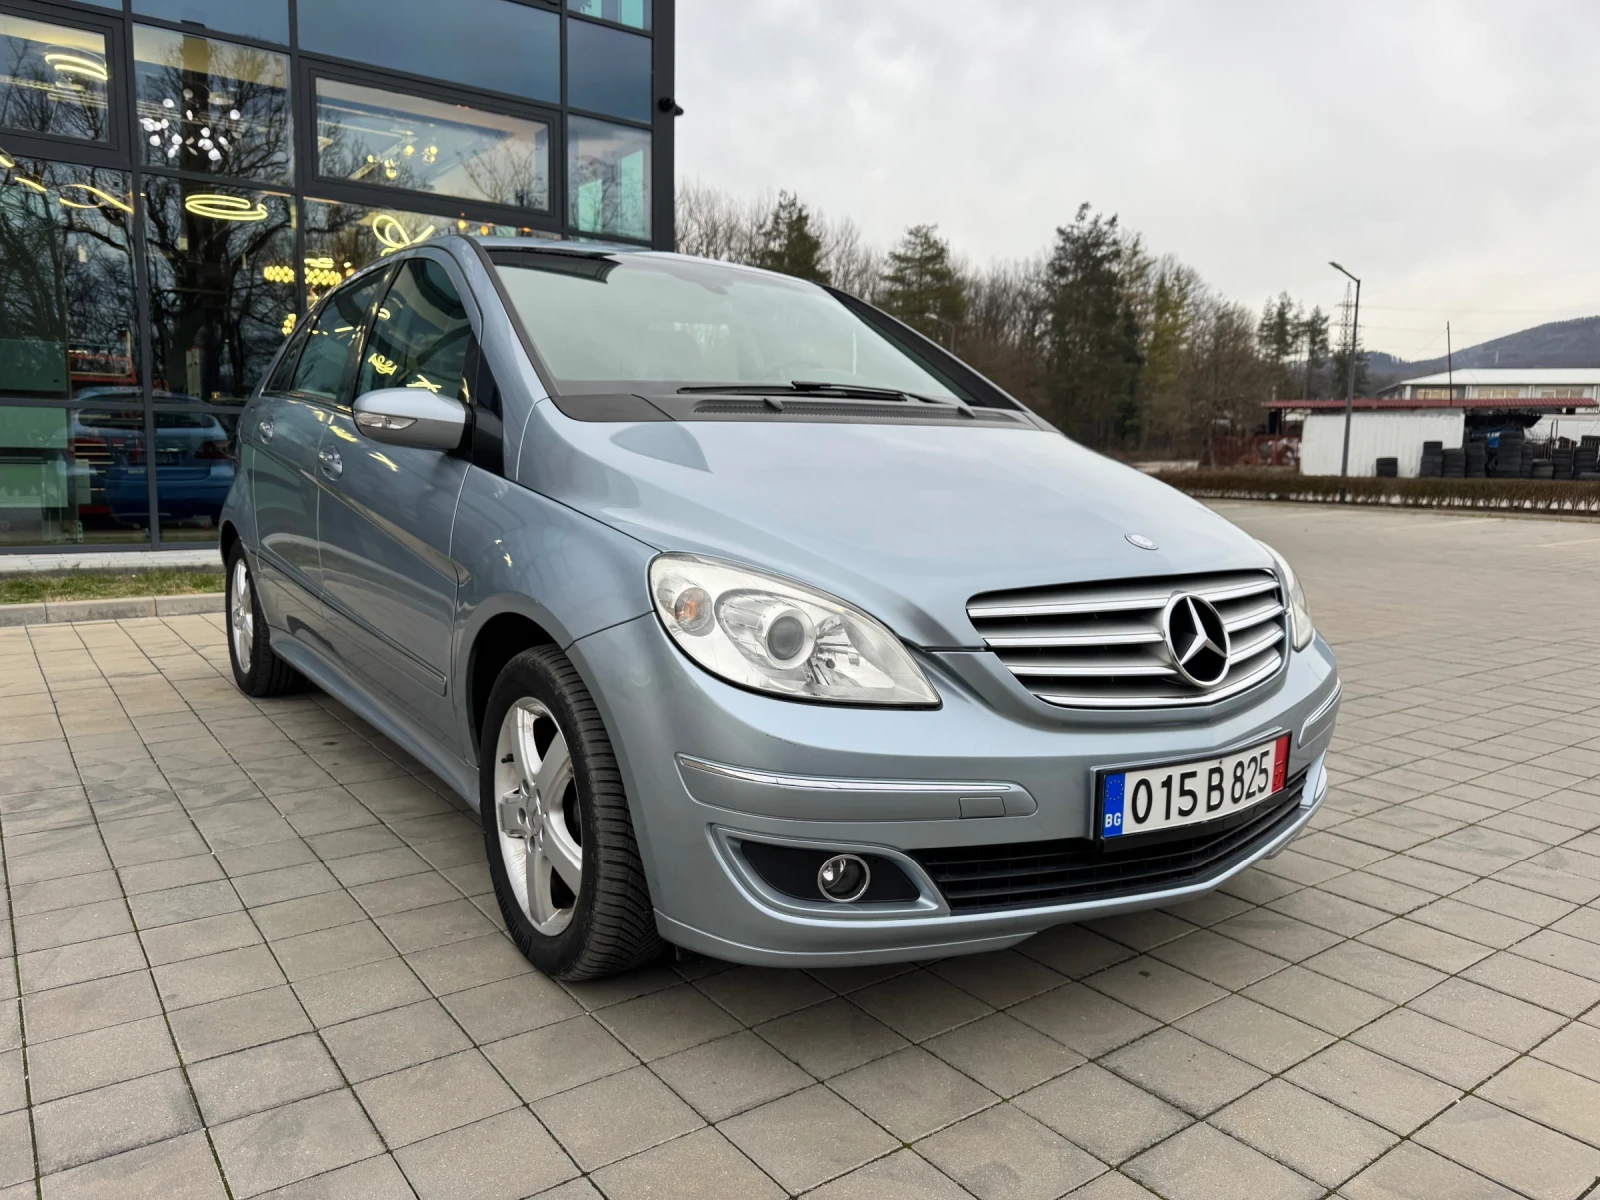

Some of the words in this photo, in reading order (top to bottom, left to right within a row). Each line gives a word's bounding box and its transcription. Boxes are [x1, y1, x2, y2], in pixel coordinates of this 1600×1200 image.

[1131, 771, 1198, 824] 015
[1206, 766, 1225, 812] B
[1231, 750, 1270, 804] 825
[1105, 812, 1121, 828] BG
